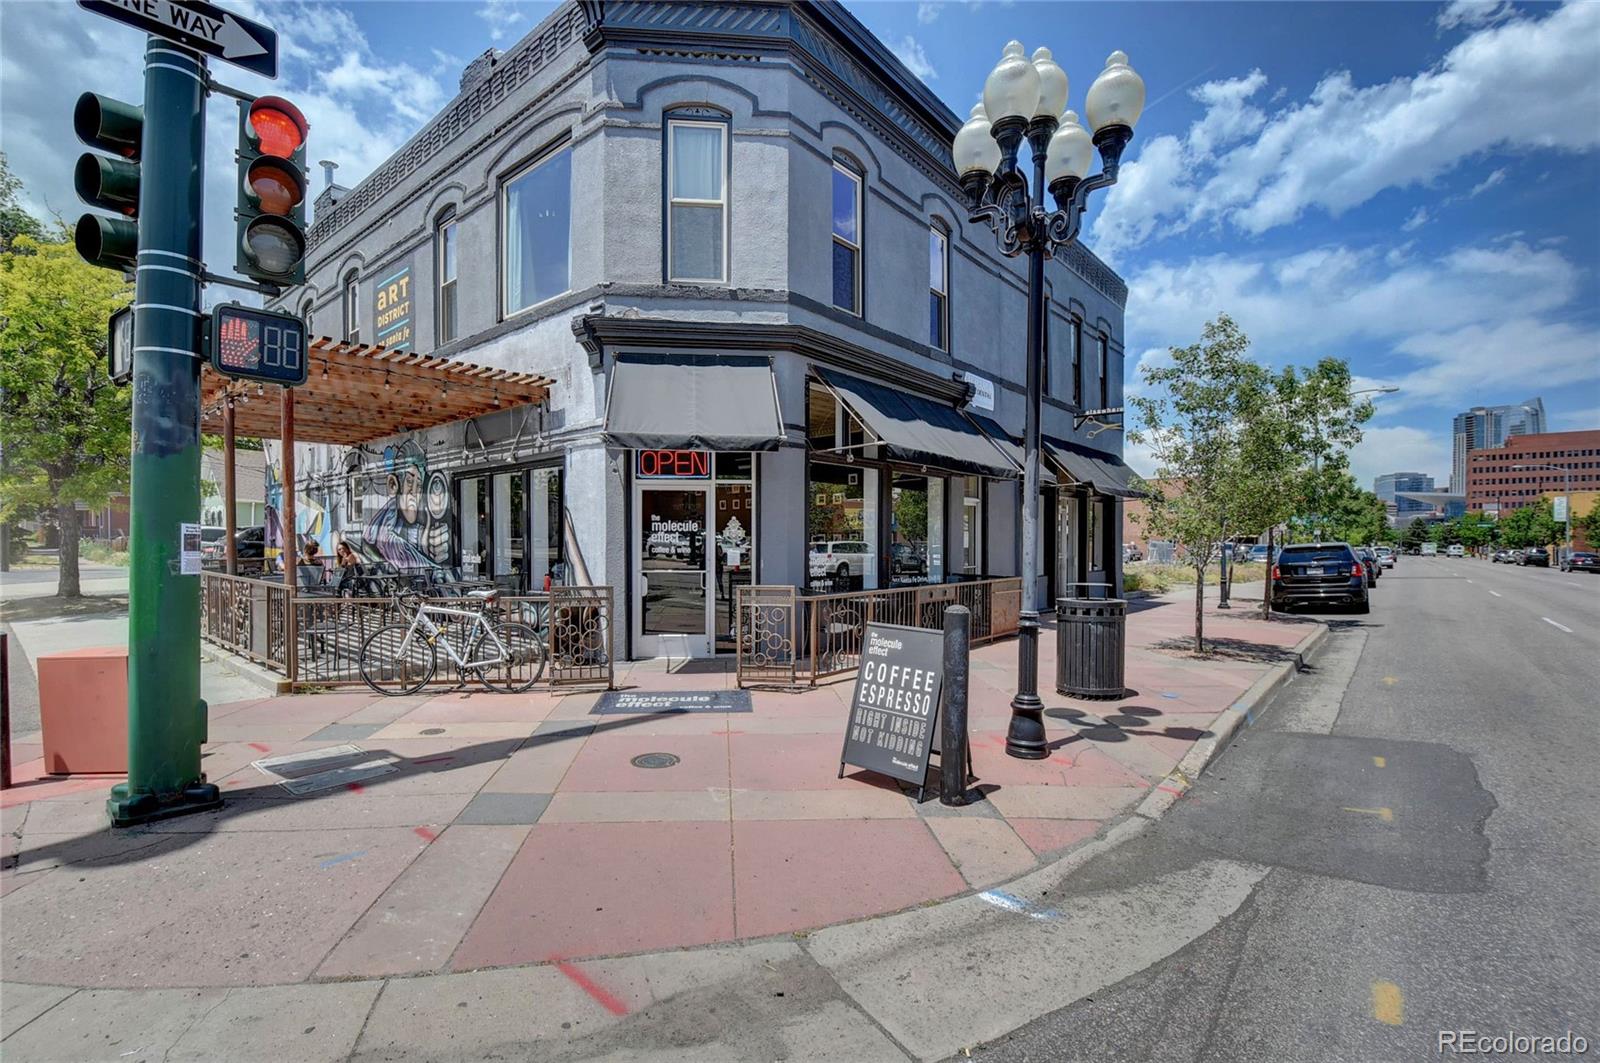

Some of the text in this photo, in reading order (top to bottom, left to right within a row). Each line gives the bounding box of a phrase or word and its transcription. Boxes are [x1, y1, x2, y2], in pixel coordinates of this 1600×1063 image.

[112, 0, 222, 40] NE WAY
[377, 301, 410, 328] DISTRICT
[641, 450, 708, 476] OPEN
[651, 520, 698, 532] molecule
[651, 531, 680, 543] effect
[651, 546, 670, 554] coffee
[868, 646, 888, 656] effect
[870, 637, 902, 650] molecule
[864, 661, 935, 692] COFFEE
[860, 682, 930, 716] ESPRESSO
[855, 707, 927, 740] RIGHT INSIDE
[852, 725, 923, 757] NOT KIDDING
